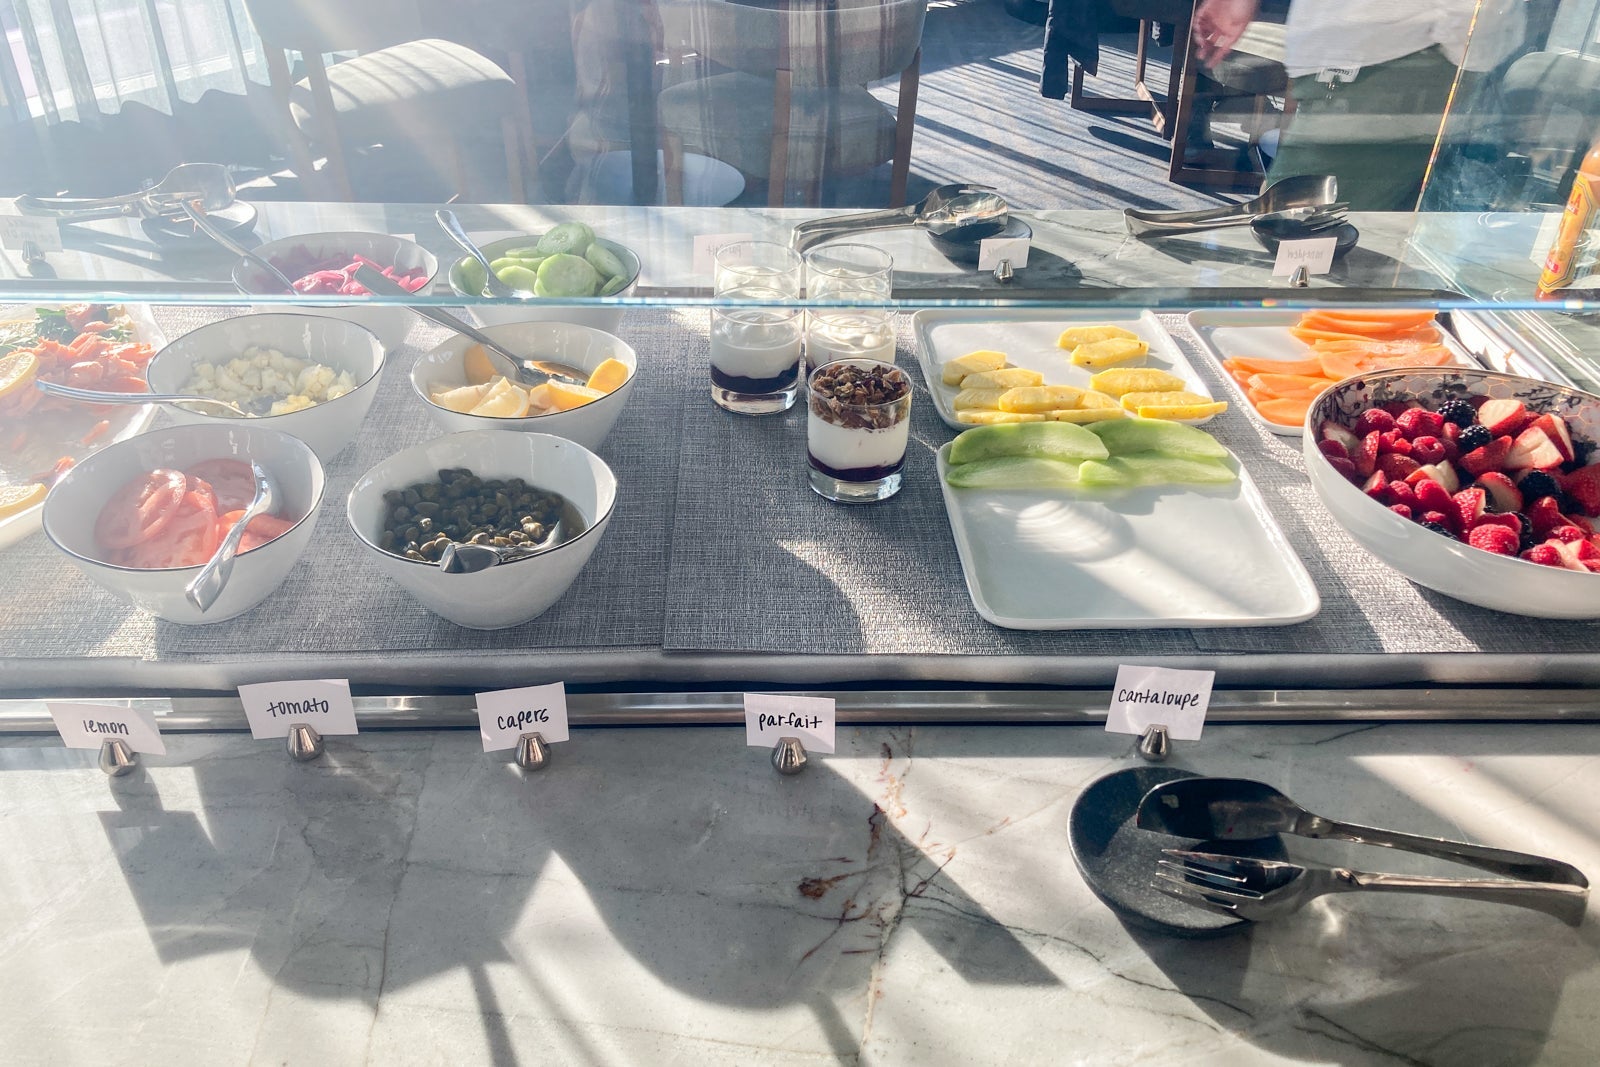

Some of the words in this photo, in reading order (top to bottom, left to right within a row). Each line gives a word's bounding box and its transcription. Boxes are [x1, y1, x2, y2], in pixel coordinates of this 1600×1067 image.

[266, 697, 329, 717] tomato
[1118, 689, 1199, 710] cantaloupe
[83, 719, 129, 735] lemon
[497, 708, 549, 730] capers
[759, 712, 823, 731] parfait
